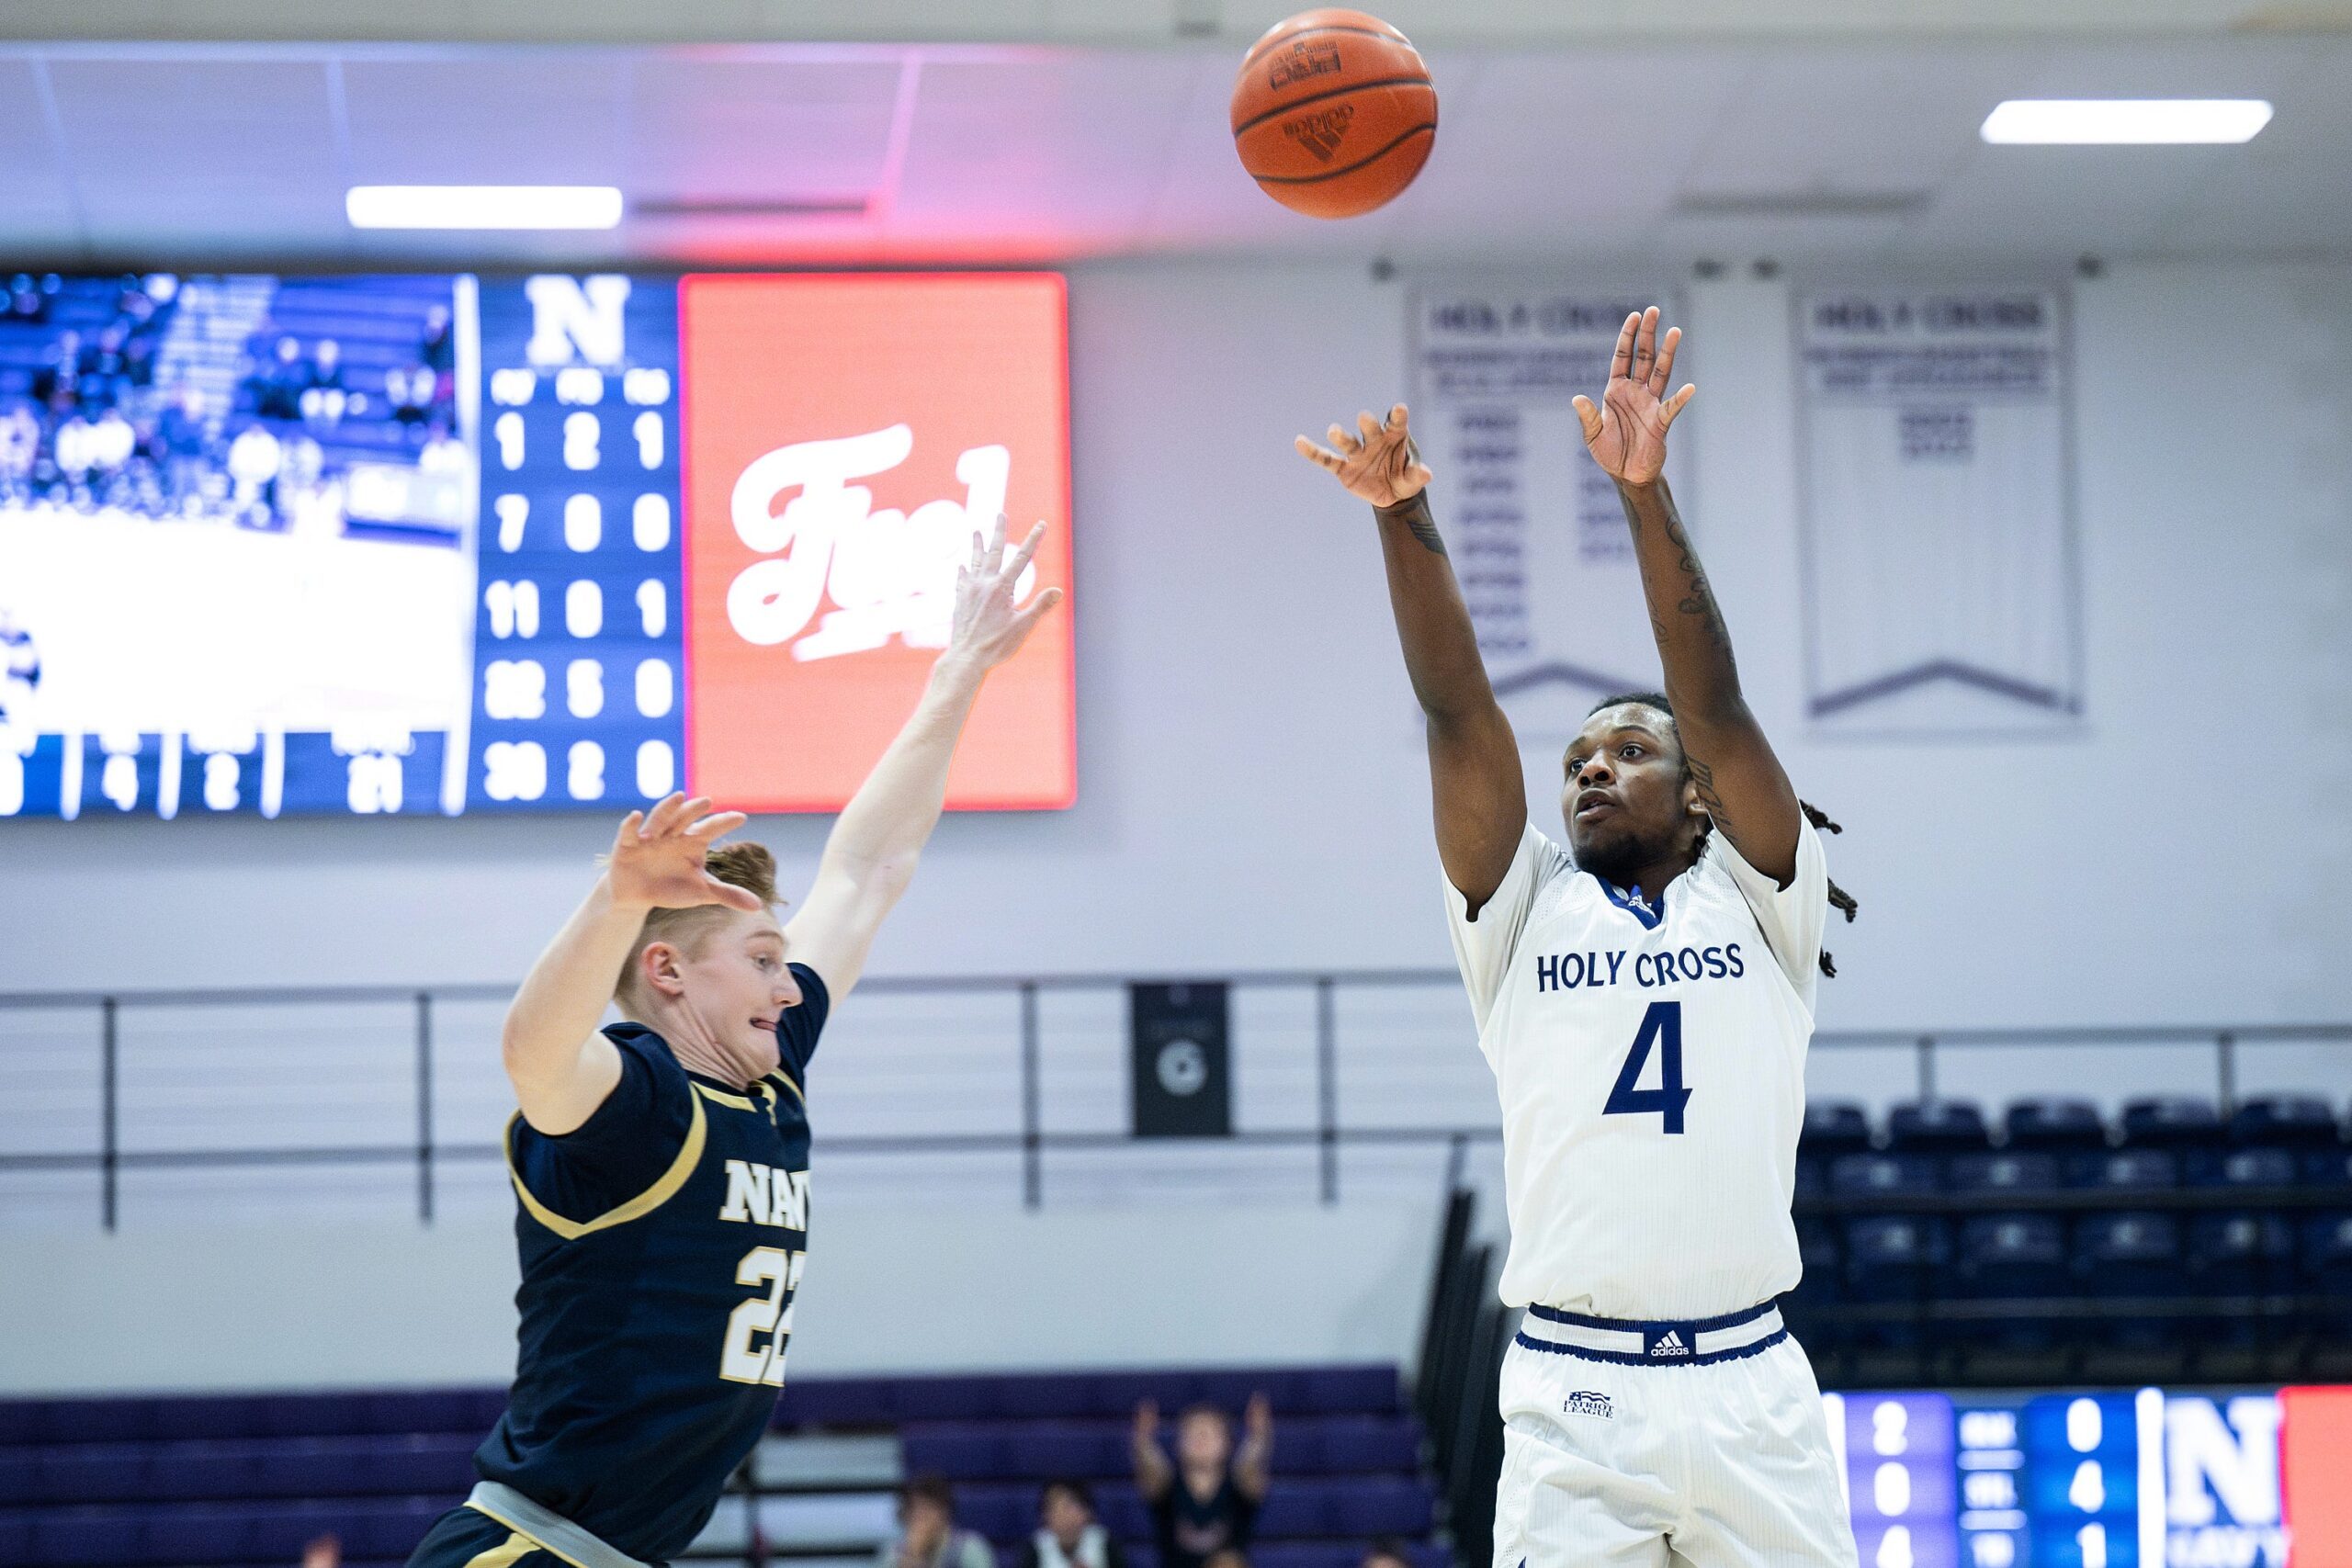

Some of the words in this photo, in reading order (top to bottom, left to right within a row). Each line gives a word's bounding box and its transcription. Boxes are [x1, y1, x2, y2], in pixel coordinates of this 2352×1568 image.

[526, 276, 630, 366] N
[497, 412, 524, 468] 1
[636, 412, 662, 468] 1
[639, 581, 665, 637] 1
[1537, 950, 1627, 993] HOLY
[1634, 942, 1745, 987] CROSS
[1601, 1001, 1693, 1134] 4
[1650, 1345, 1690, 1357] adidas
[1564, 1405, 1613, 1419] LEAGUE
[1565, 1400, 1615, 1412] PATRIOT
[2165, 1397, 2285, 1526] N
